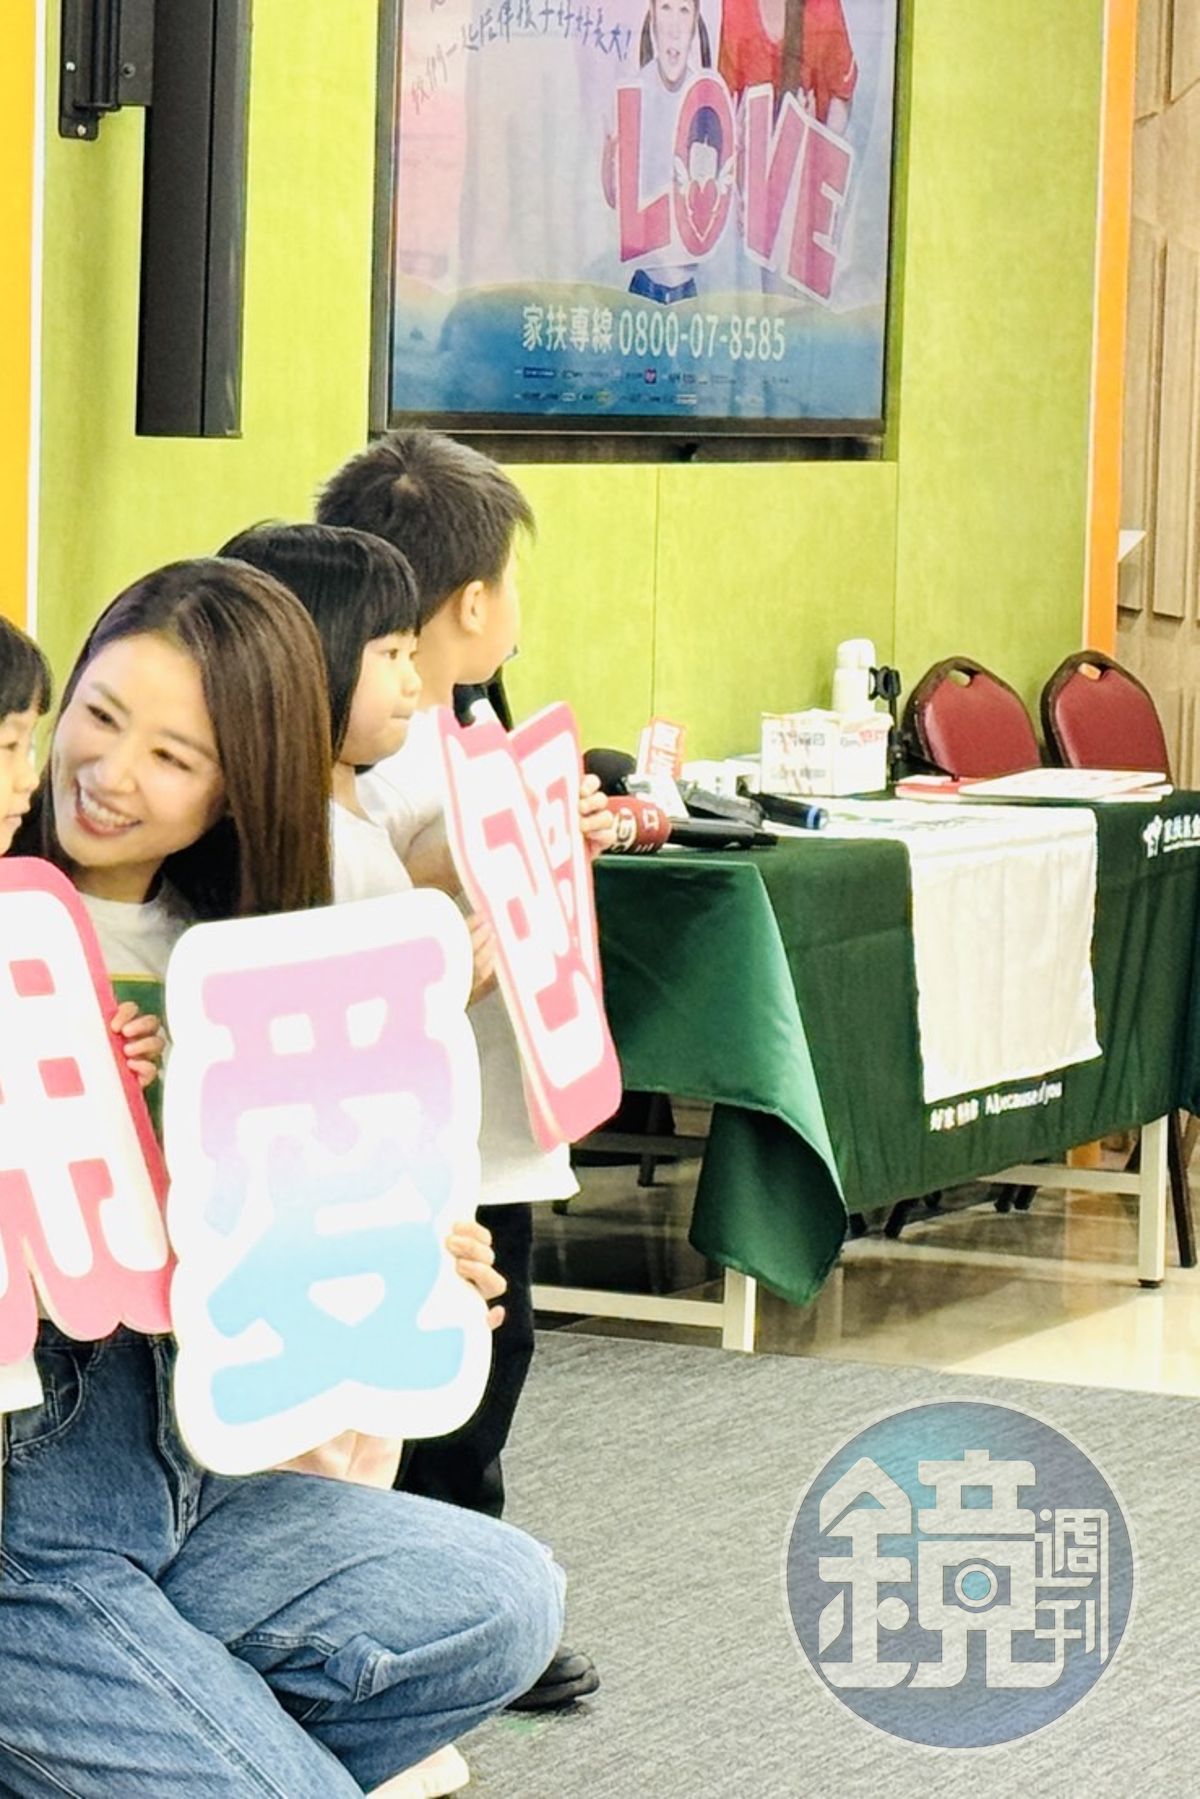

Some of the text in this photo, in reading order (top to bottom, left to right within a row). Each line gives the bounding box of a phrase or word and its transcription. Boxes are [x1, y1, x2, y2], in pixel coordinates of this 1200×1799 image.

[616, 76, 853, 300] LOVE
[522, 304, 785, 361] 家扶專線 0800-07-8585
[202, 936, 464, 1426] 愛
